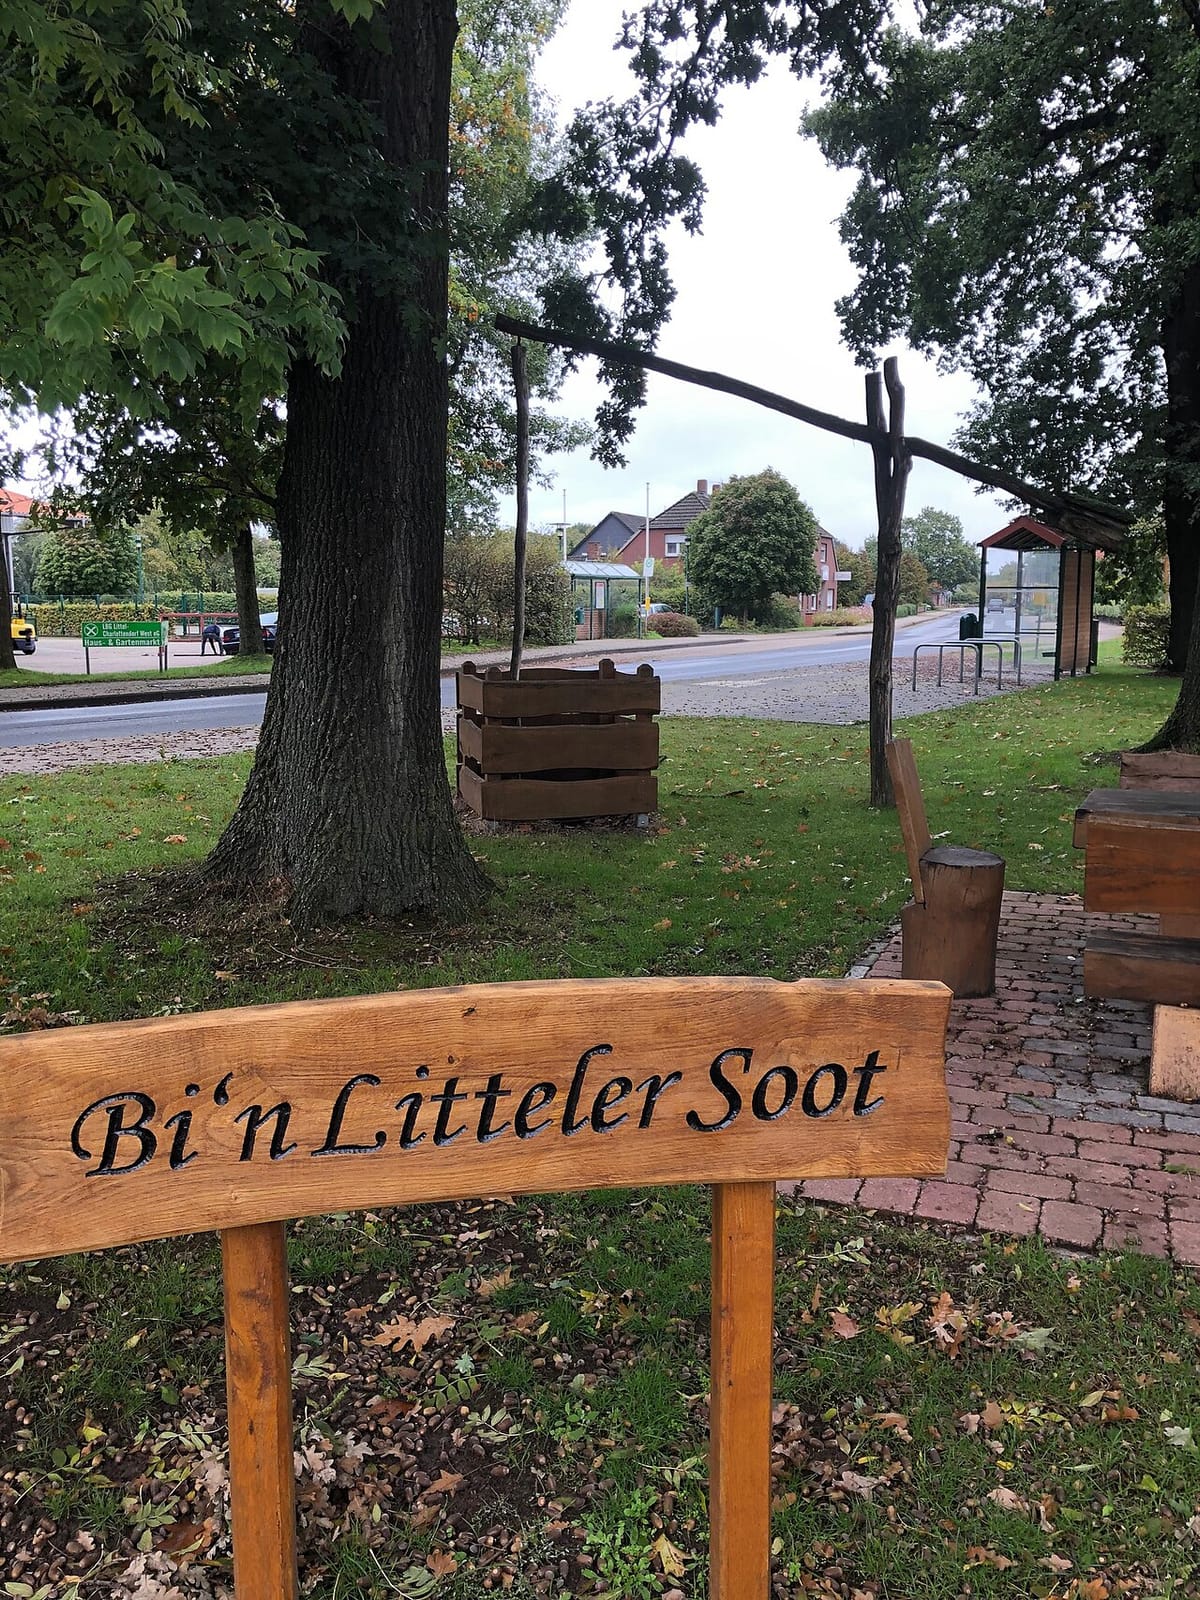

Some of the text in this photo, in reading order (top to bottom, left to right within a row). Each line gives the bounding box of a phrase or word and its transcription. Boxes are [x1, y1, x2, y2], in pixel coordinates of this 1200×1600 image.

[115, 638, 161, 646] Gartenmarkt
[311, 1043, 683, 1157] Litteler
[686, 1047, 888, 1133] Soot
